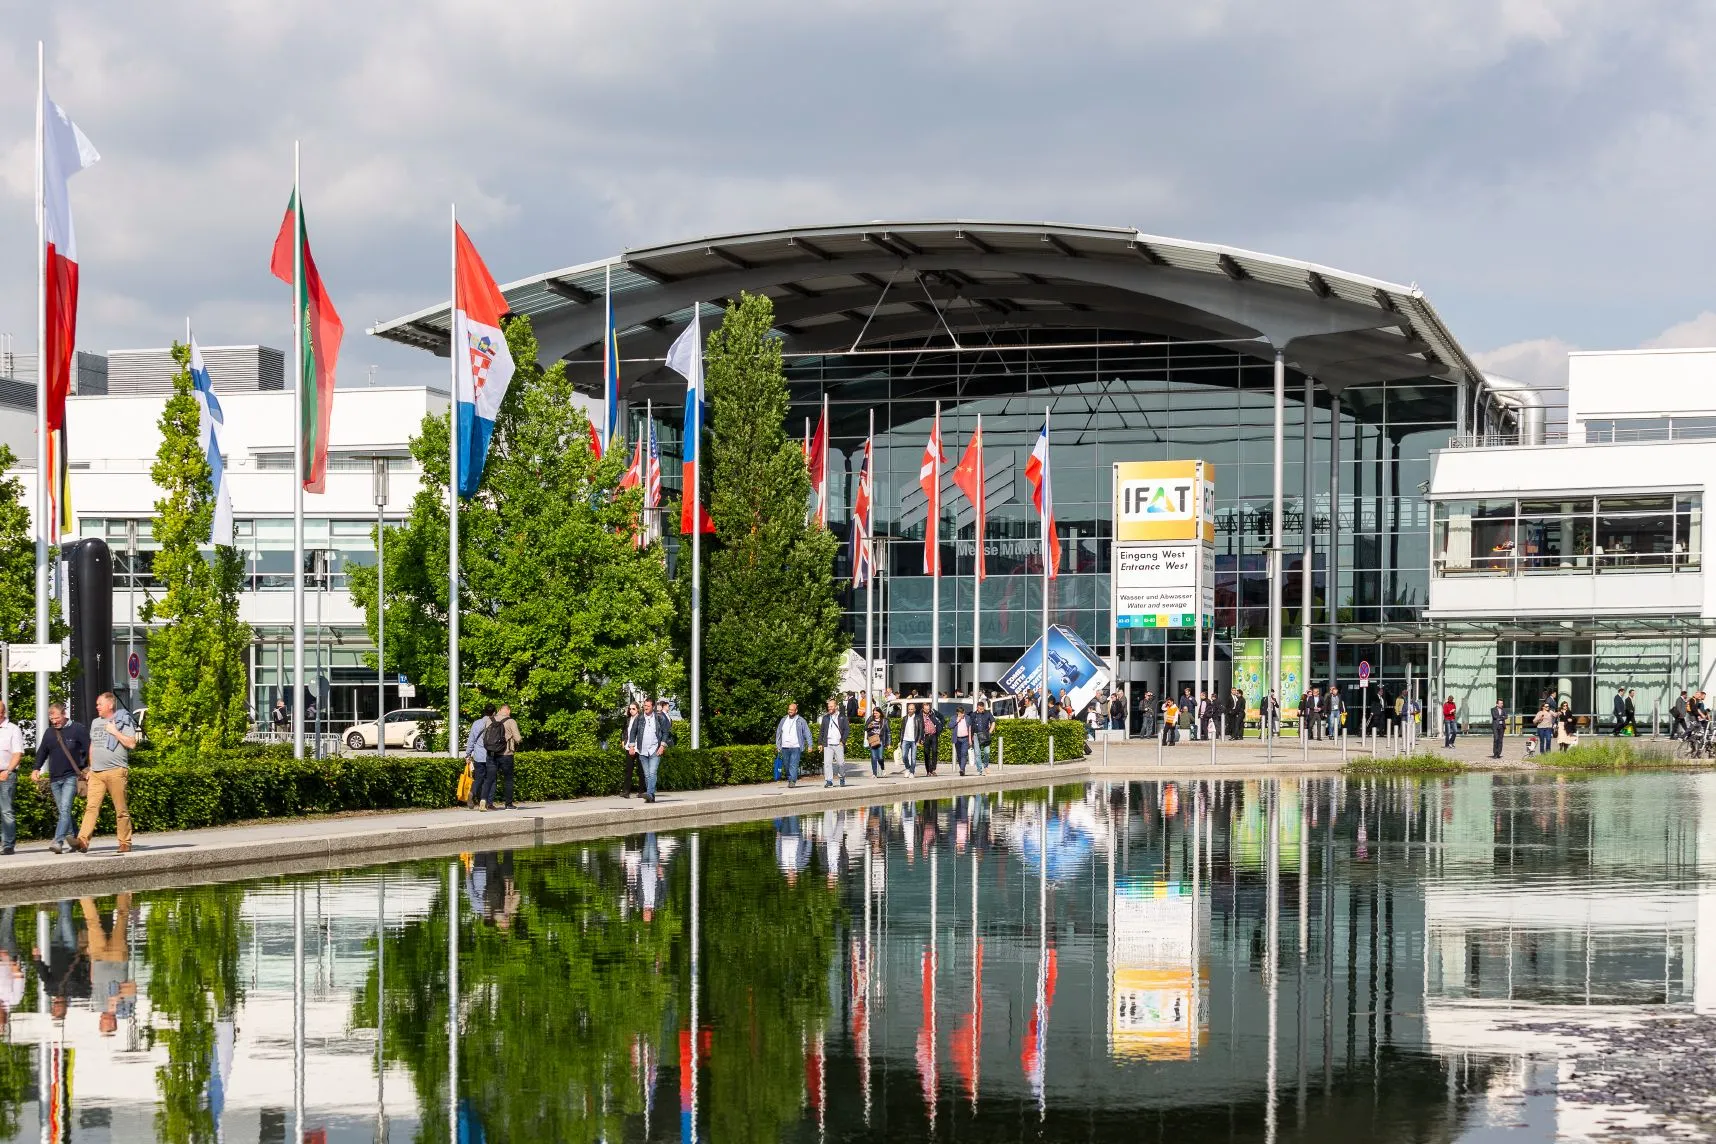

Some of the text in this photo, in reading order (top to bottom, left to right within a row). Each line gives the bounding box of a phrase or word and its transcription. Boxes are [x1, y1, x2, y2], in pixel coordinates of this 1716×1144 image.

[1124, 486, 1190, 514] IFAT
[957, 543, 998, 556] Mese
[1120, 551, 1185, 561] Eingang West
[1120, 561, 1188, 571] Entrance West
[1006, 665, 1026, 685] COMES
[1010, 673, 1026, 690] WITH
